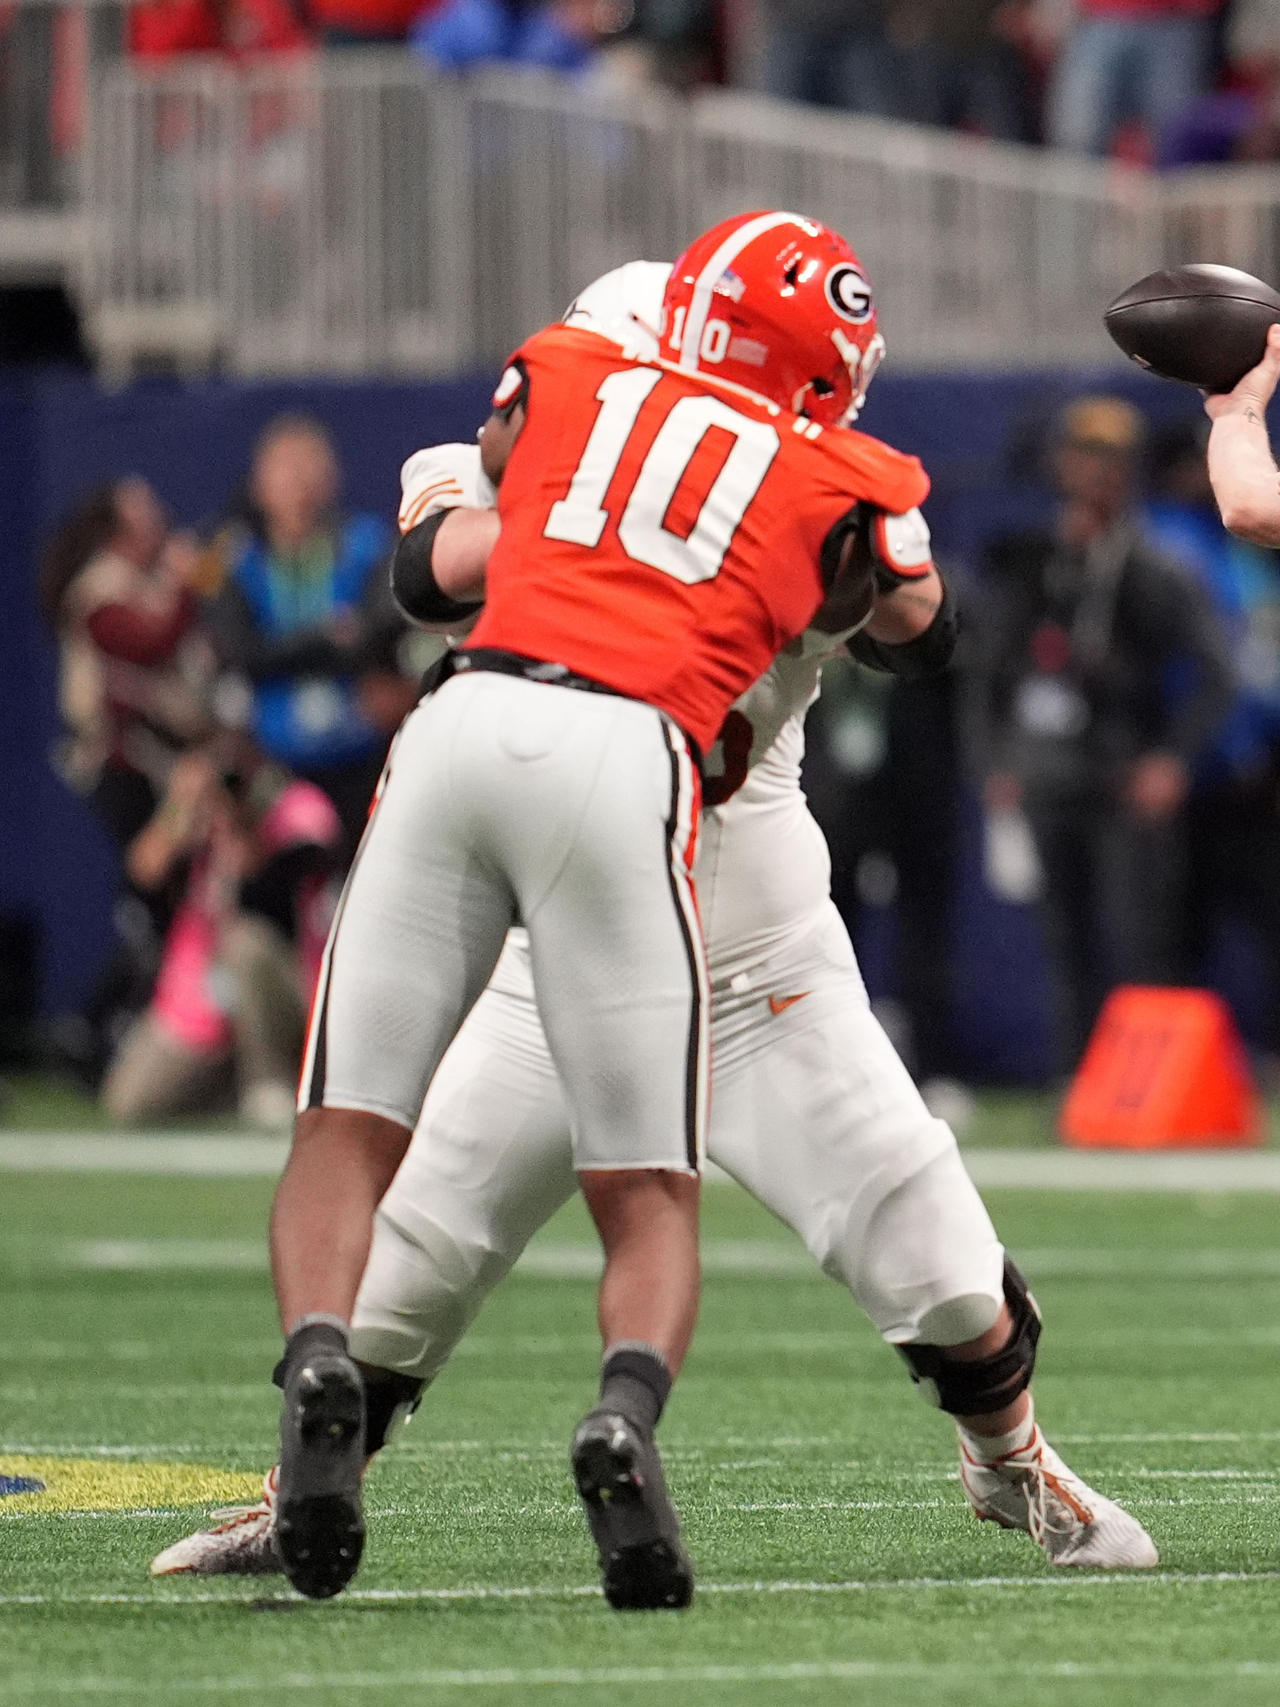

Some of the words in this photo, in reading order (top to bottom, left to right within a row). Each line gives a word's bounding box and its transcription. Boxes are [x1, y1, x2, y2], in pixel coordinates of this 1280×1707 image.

[833, 269, 871, 316] G
[668, 305, 732, 364] 10
[543, 365, 781, 585] 10
